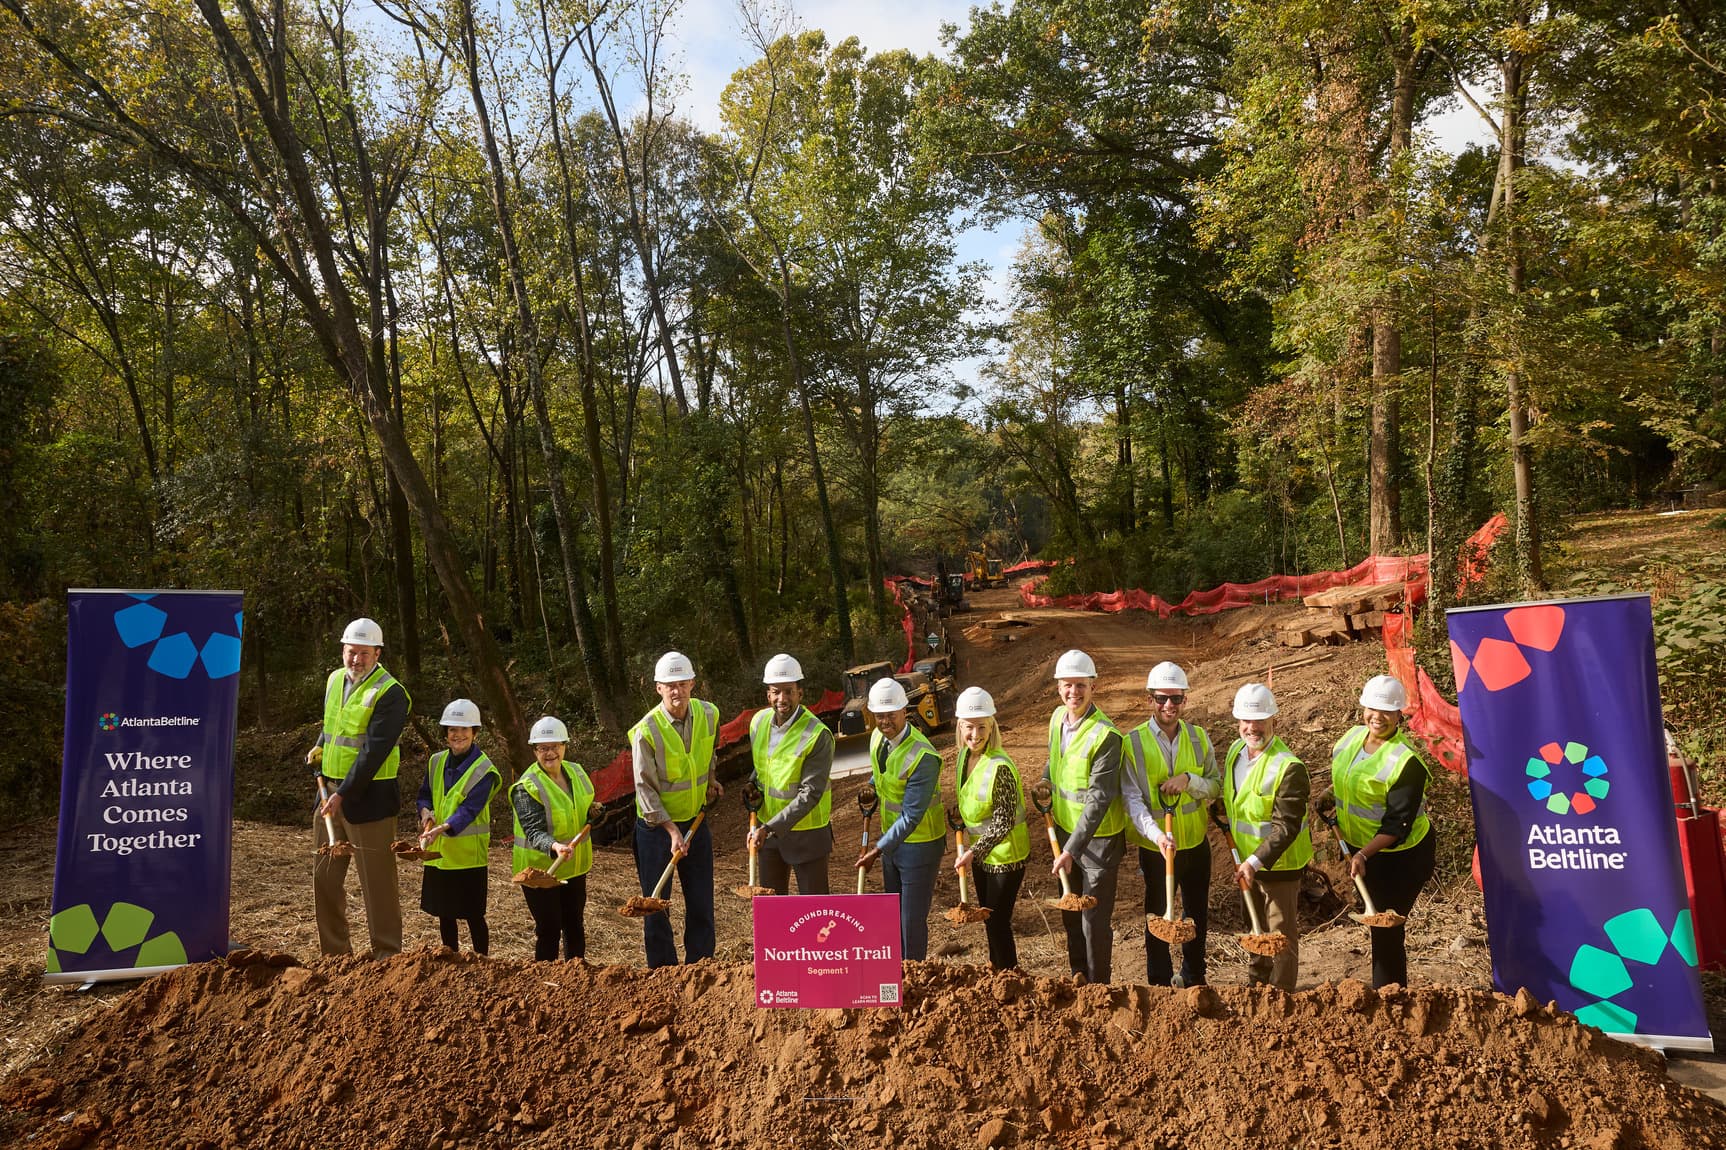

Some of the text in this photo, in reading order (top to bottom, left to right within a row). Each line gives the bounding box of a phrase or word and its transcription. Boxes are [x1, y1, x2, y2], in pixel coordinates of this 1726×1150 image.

[104, 751, 192, 770] Where
[100, 778, 193, 798] Atlanta
[102, 804, 188, 824] Comes
[87, 830, 202, 856] Together
[1527, 823, 1621, 845] Atlanta
[1529, 848, 1625, 870] Beltline
[789, 909, 865, 933] GROUNDBREAKING
[764, 946, 892, 961] Northwest Trail
[808, 966, 849, 976] Segment 1
